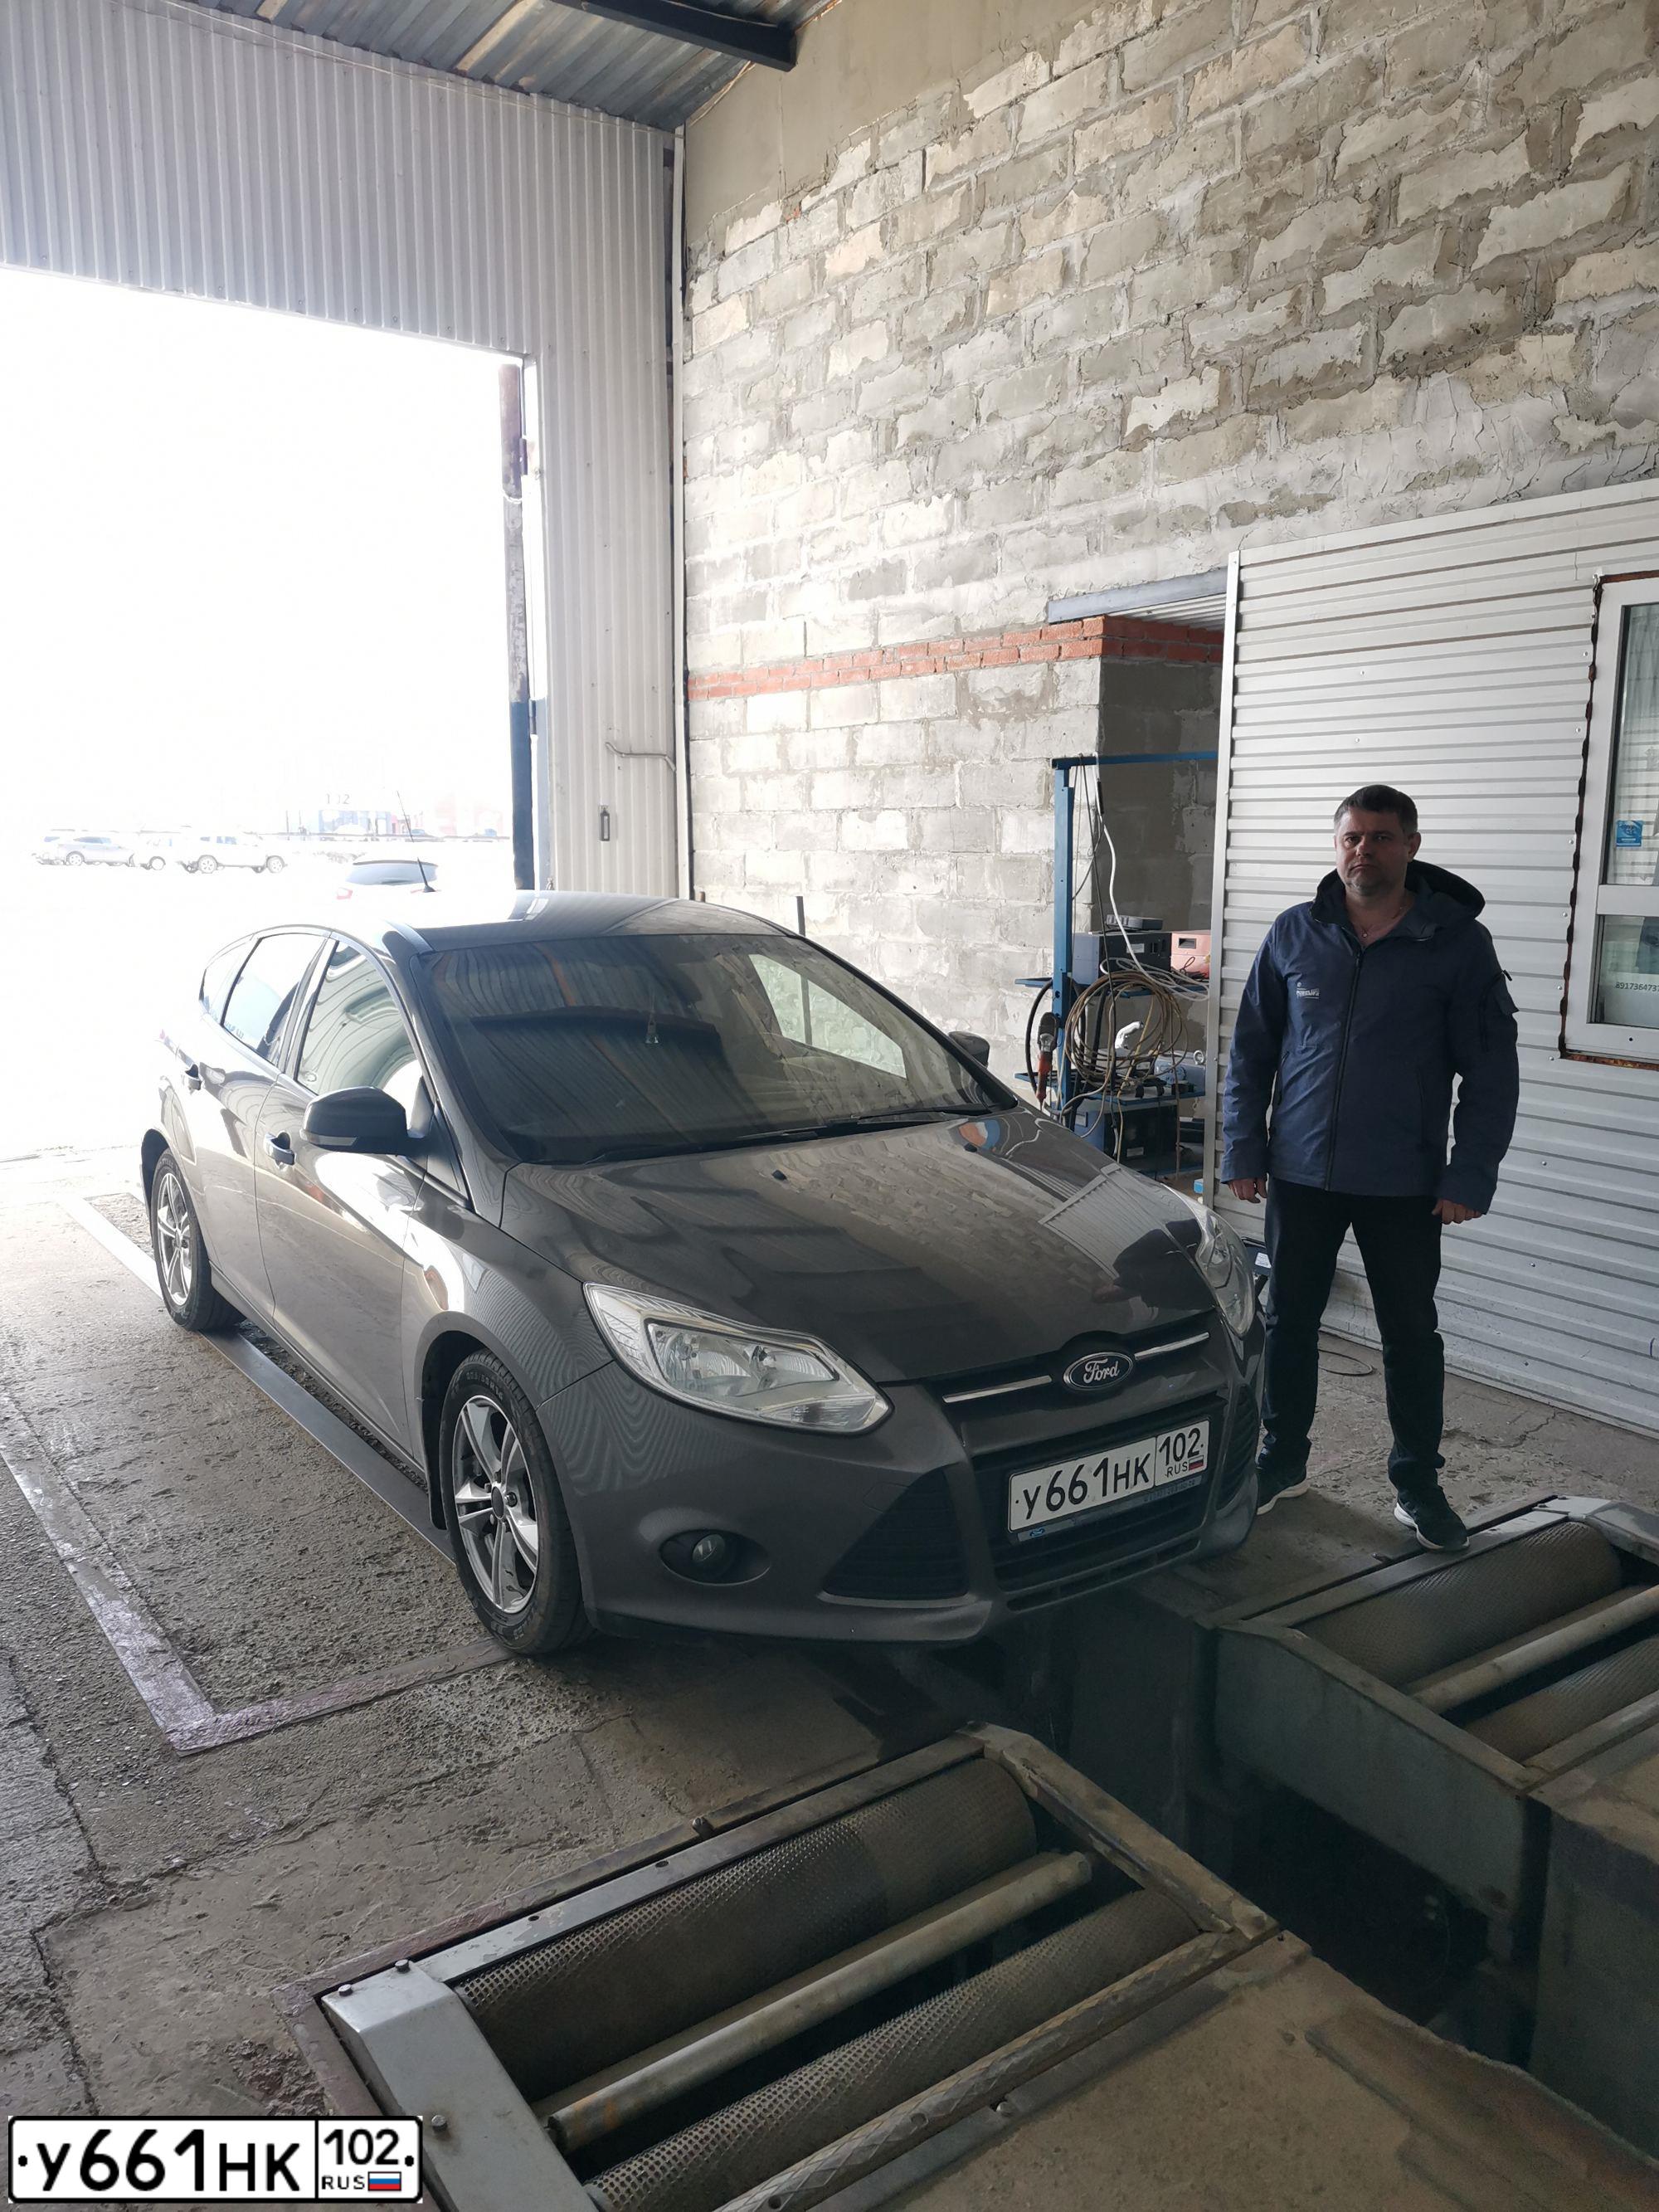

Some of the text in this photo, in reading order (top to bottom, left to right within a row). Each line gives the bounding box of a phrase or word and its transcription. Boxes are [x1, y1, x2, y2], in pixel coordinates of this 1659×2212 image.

[1083, 1358, 1120, 1384] Ford
[1023, 1453, 1151, 1520] У661НК
[1159, 1428, 1201, 1466] 102
[1166, 1461, 1188, 1478] RUS
